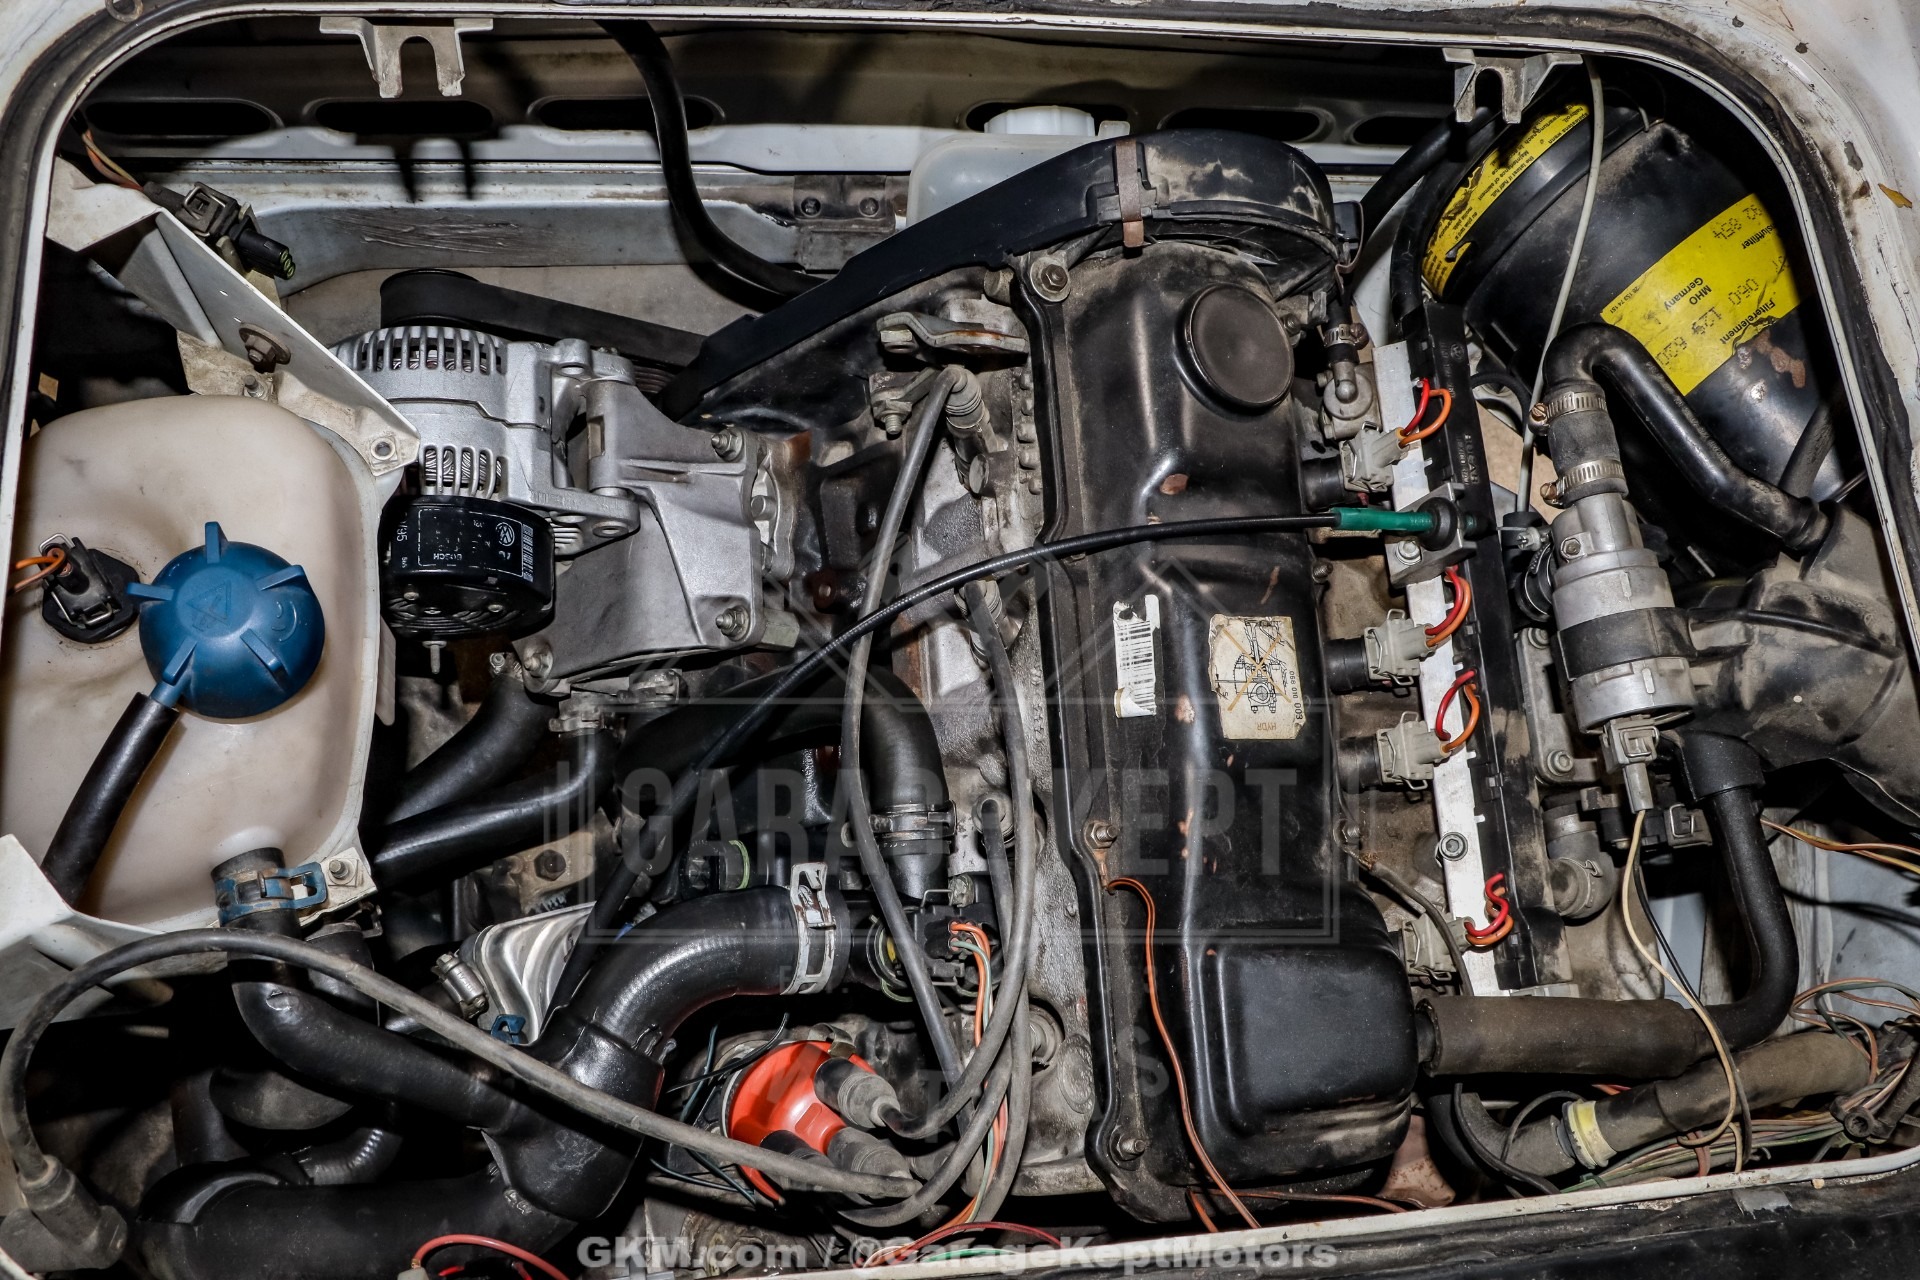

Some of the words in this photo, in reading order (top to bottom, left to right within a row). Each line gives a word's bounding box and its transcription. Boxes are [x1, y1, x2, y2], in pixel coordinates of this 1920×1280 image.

[1663, 277, 1704, 311] Germany
[1687, 284, 1711, 306] MHO
[1728, 278, 1759, 306] 060
[1720, 298, 1775, 344] Filterelement
[1295, 703, 1304, 720] 003
[1256, 722, 1277, 731] HYDR
